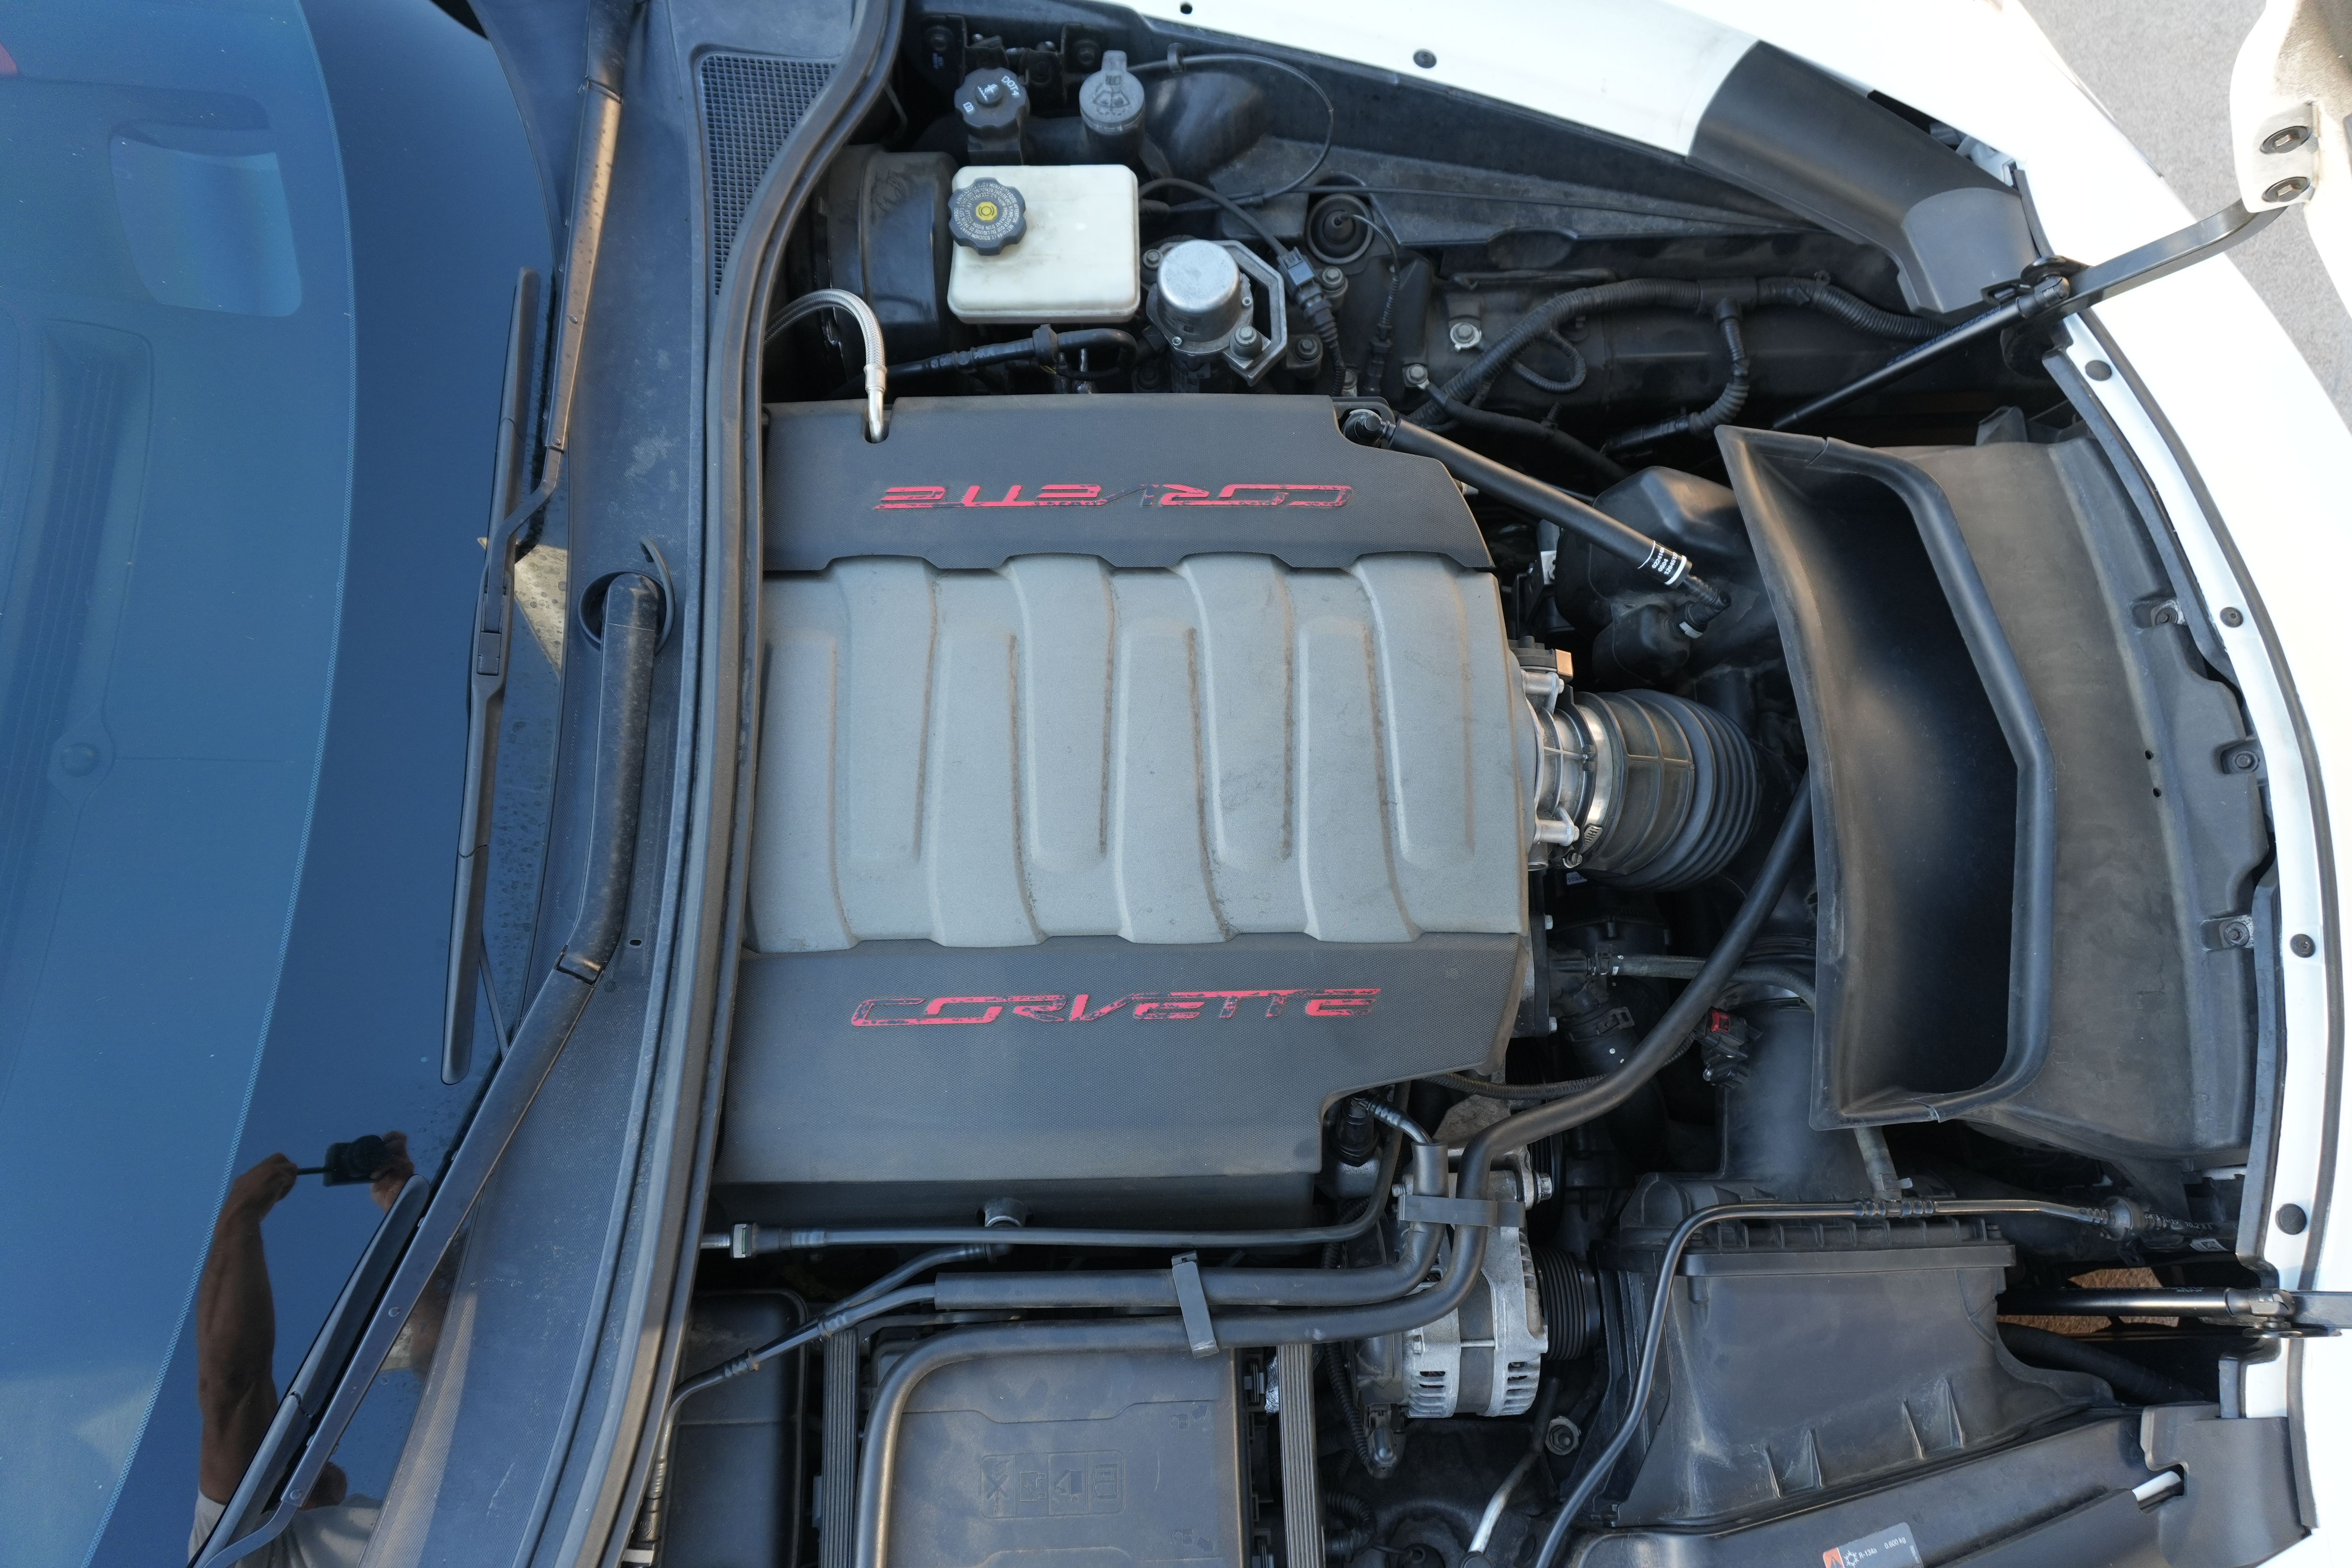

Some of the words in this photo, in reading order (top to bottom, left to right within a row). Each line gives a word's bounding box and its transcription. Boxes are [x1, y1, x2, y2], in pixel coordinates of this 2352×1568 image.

[993, 188, 1008, 199] BEFORE
[999, 186, 1011, 195] FLUID
[1008, 193, 1017, 203] DOT3
[961, 217, 970, 228] FREIN
[994, 207, 1007, 227] PROVENANT
[959, 225, 972, 236] AVANT
[996, 224, 1014, 238] NETTOYER
[874, 484, 1354, 509] CORVETTE
[1658, 558, 1668, 572] 0504
[851, 988, 1381, 1026] CORVETTE
[1859, 1548, 1878, 1559] R-134a
[1884, 1539, 1898, 1550] 0.600
